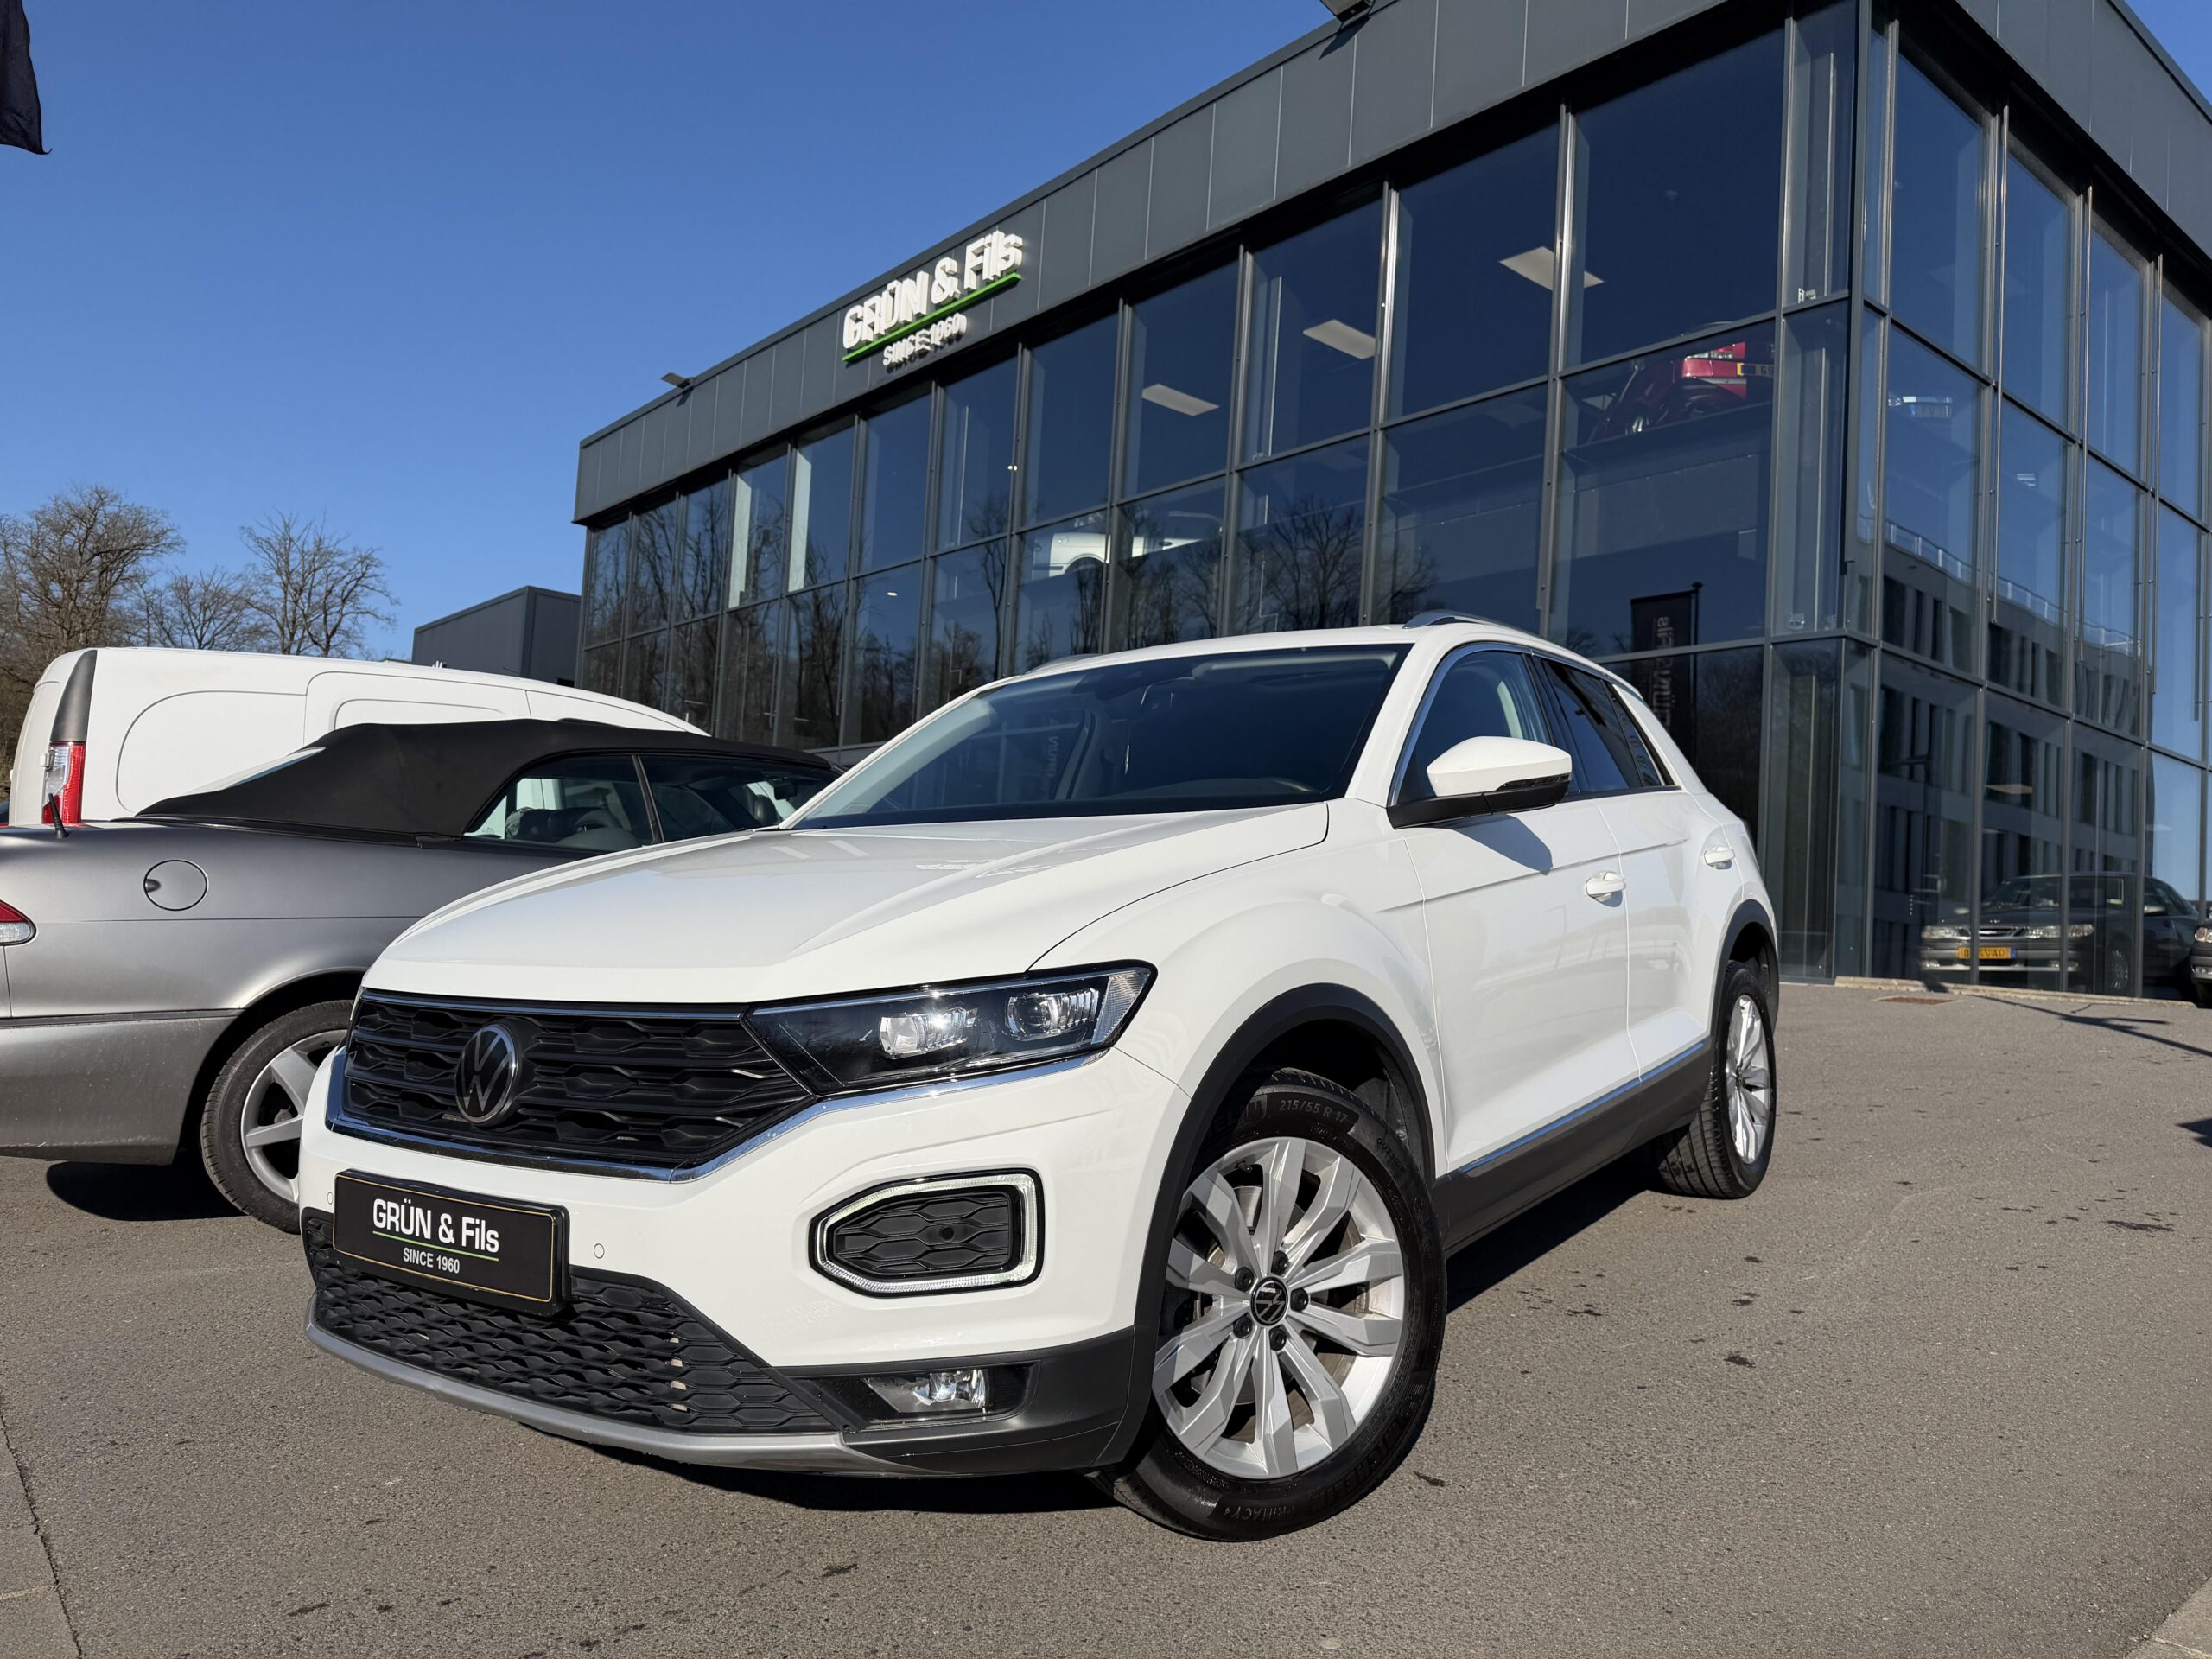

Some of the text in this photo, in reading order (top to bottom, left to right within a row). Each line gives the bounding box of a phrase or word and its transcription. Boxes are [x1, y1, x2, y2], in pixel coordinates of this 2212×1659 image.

[931, 257, 962, 305] &
[963, 229, 1024, 291] Fils
[882, 312, 968, 367] SINCE 1960
[1278, 1098, 1349, 1123] 215/55 R 17
[372, 1198, 499, 1254] GRÜN & Fils
[403, 1247, 461, 1274] SINCE 1960
